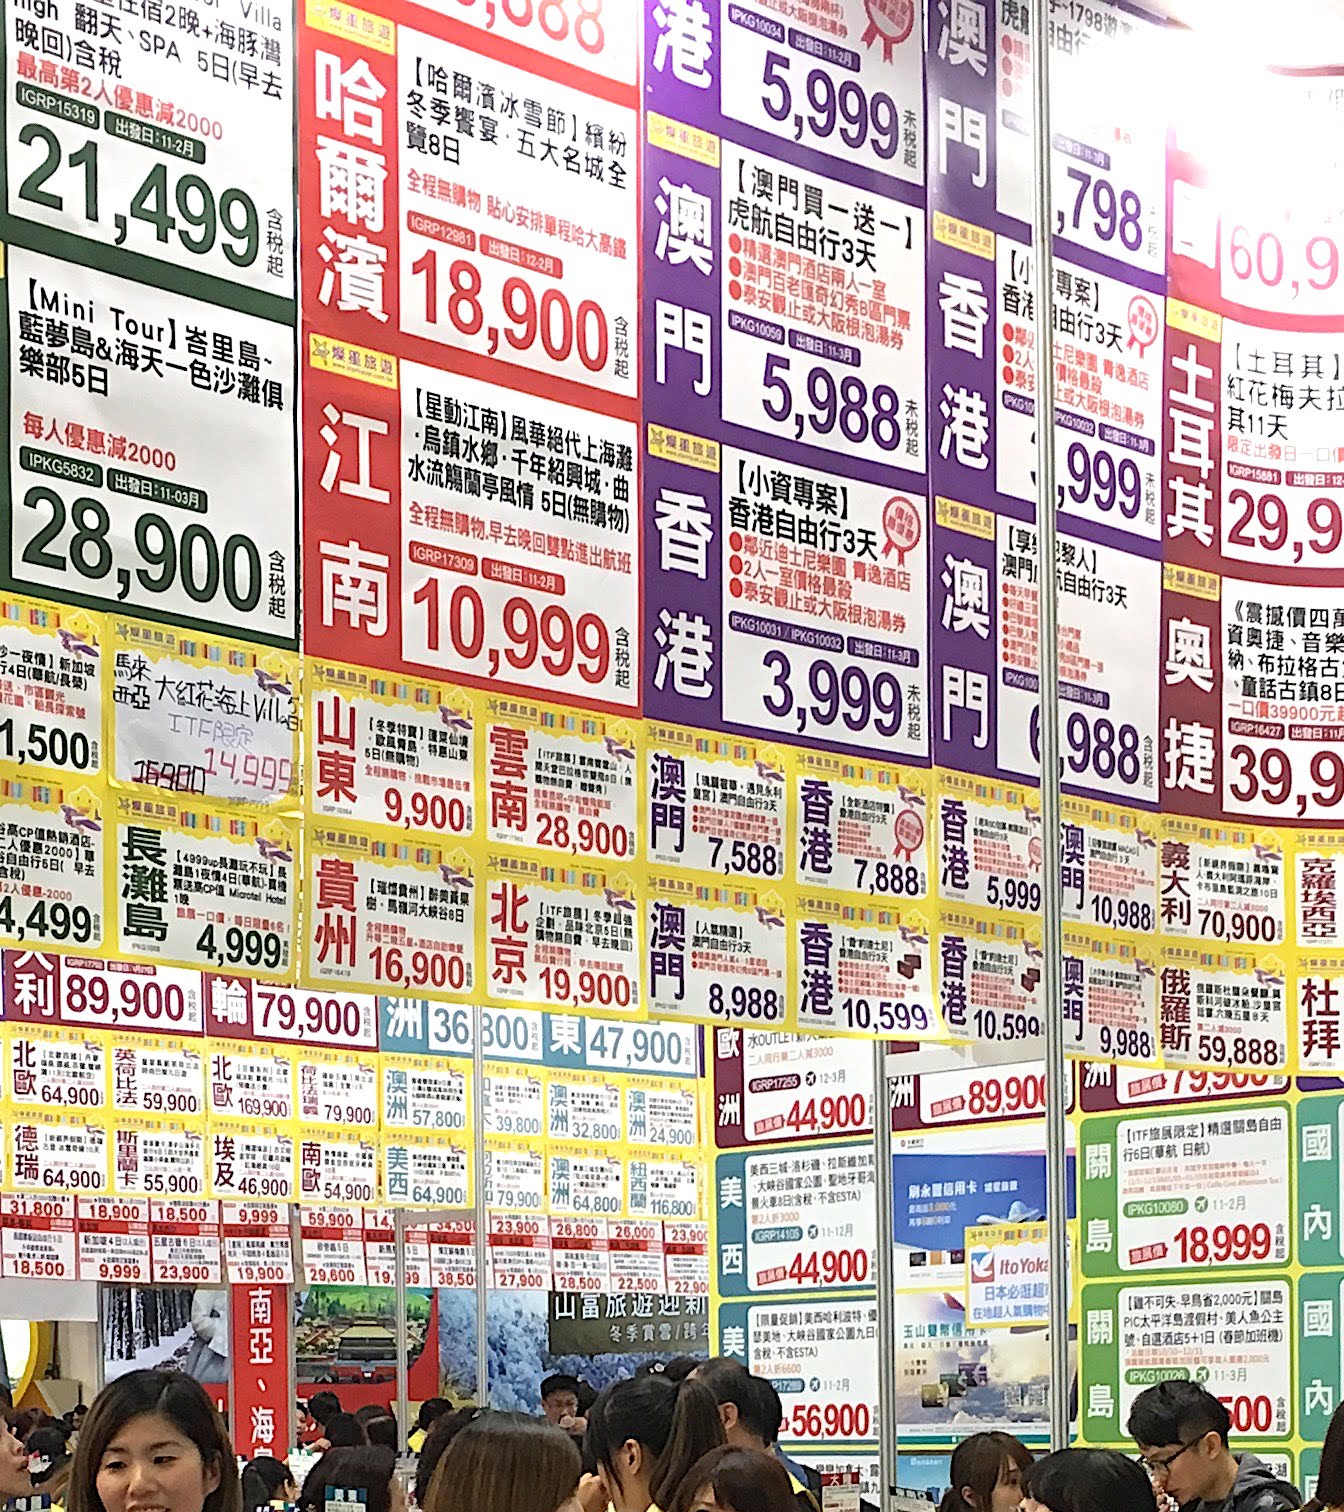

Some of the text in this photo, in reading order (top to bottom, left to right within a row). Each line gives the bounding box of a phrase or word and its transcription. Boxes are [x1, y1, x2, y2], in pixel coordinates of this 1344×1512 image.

[16, 52, 223, 140] 最高第2人優惠減2000
[20, 86, 96, 125] IGRP15319
[414, 55, 628, 160] 【哈爾濱冰雪節】繽紛
[761, 50, 900, 160] 5,999
[406, 120, 462, 168] 覽8日
[18, 123, 259, 268] 21,499
[314, 50, 392, 326] 哈爾濱
[738, 158, 912, 250] 【澳門買一送一】
[728, 197, 877, 273] 虎航自由行3天
[409, 248, 608, 372] 18,900
[654, 175, 714, 399] 澳門
[19, 310, 283, 411] 藍夢島&海天一色沙灘俱
[20, 345, 108, 397] 樂部5日
[937, 271, 988, 471] 香港
[24, 411, 176, 472] 每人優惠減2000
[762, 353, 902, 459] 5,988
[1228, 405, 1288, 440] 其11天
[29, 453, 94, 482] IPKG5832
[1167, 342, 1215, 549] 土耳其
[319, 403, 391, 638] 江南
[733, 459, 851, 520] 【小資專案】
[21, 486, 261, 613] 28,900
[413, 545, 475, 572] IGRP17309
[728, 496, 878, 562] 香港自由行3天
[413, 577, 610, 684] 10,999
[653, 489, 715, 701] 香港
[762, 649, 904, 738] 3,999
[1163, 616, 1217, 796] 奧捷
[316, 696, 357, 803] 山東
[489, 725, 528, 832] 雲南
[384, 787, 465, 832] 9,900
[536, 812, 627, 858] 28,900
[650, 753, 686, 854] 澳門
[799, 779, 833, 875] 香港
[708, 837, 777, 877] 7,588
[853, 859, 920, 897] 7,888
[941, 799, 970, 890] 香港
[122, 826, 168, 942] 長灘島
[314, 858, 359, 968] 貴州
[987, 877, 1041, 912] 5,999
[1090, 896, 1151, 932] 10,988
[1160, 840, 1192, 926] 義大利
[1301, 857, 1337, 938] 克羅埃西亞
[196, 924, 281, 970] 4,999
[490, 882, 529, 985] 北京
[650, 901, 686, 1001] 澳門
[1197, 908, 1276, 944] 70,900
[66, 972, 185, 1023] 89,900
[368, 947, 464, 989] 16,900
[539, 966, 630, 1008] 19,900
[708, 983, 778, 1022] 8,988
[799, 922, 834, 1018] 香港
[257, 992, 360, 1037] 79,900
[842, 998, 928, 1034] 10,599
[1099, 1028, 1151, 1059] 9,988
[1159, 966, 1192, 1052] 俄羅斯
[1301, 978, 1340, 1059] 杜拜
[589, 1028, 682, 1067] 47,900
[1197, 1035, 1279, 1068] 59,888
[143, 1092, 197, 1113] 59,900
[786, 1094, 865, 1132] 44,900
[238, 1176, 288, 1197] 46,900
[720, 1176, 743, 1276] 美西
[1174, 1222, 1272, 1267] 18,999
[560, 1276, 601, 1291] 28,500
[789, 1248, 867, 1288] 44,900
[792, 1403, 870, 1439] 56,900
